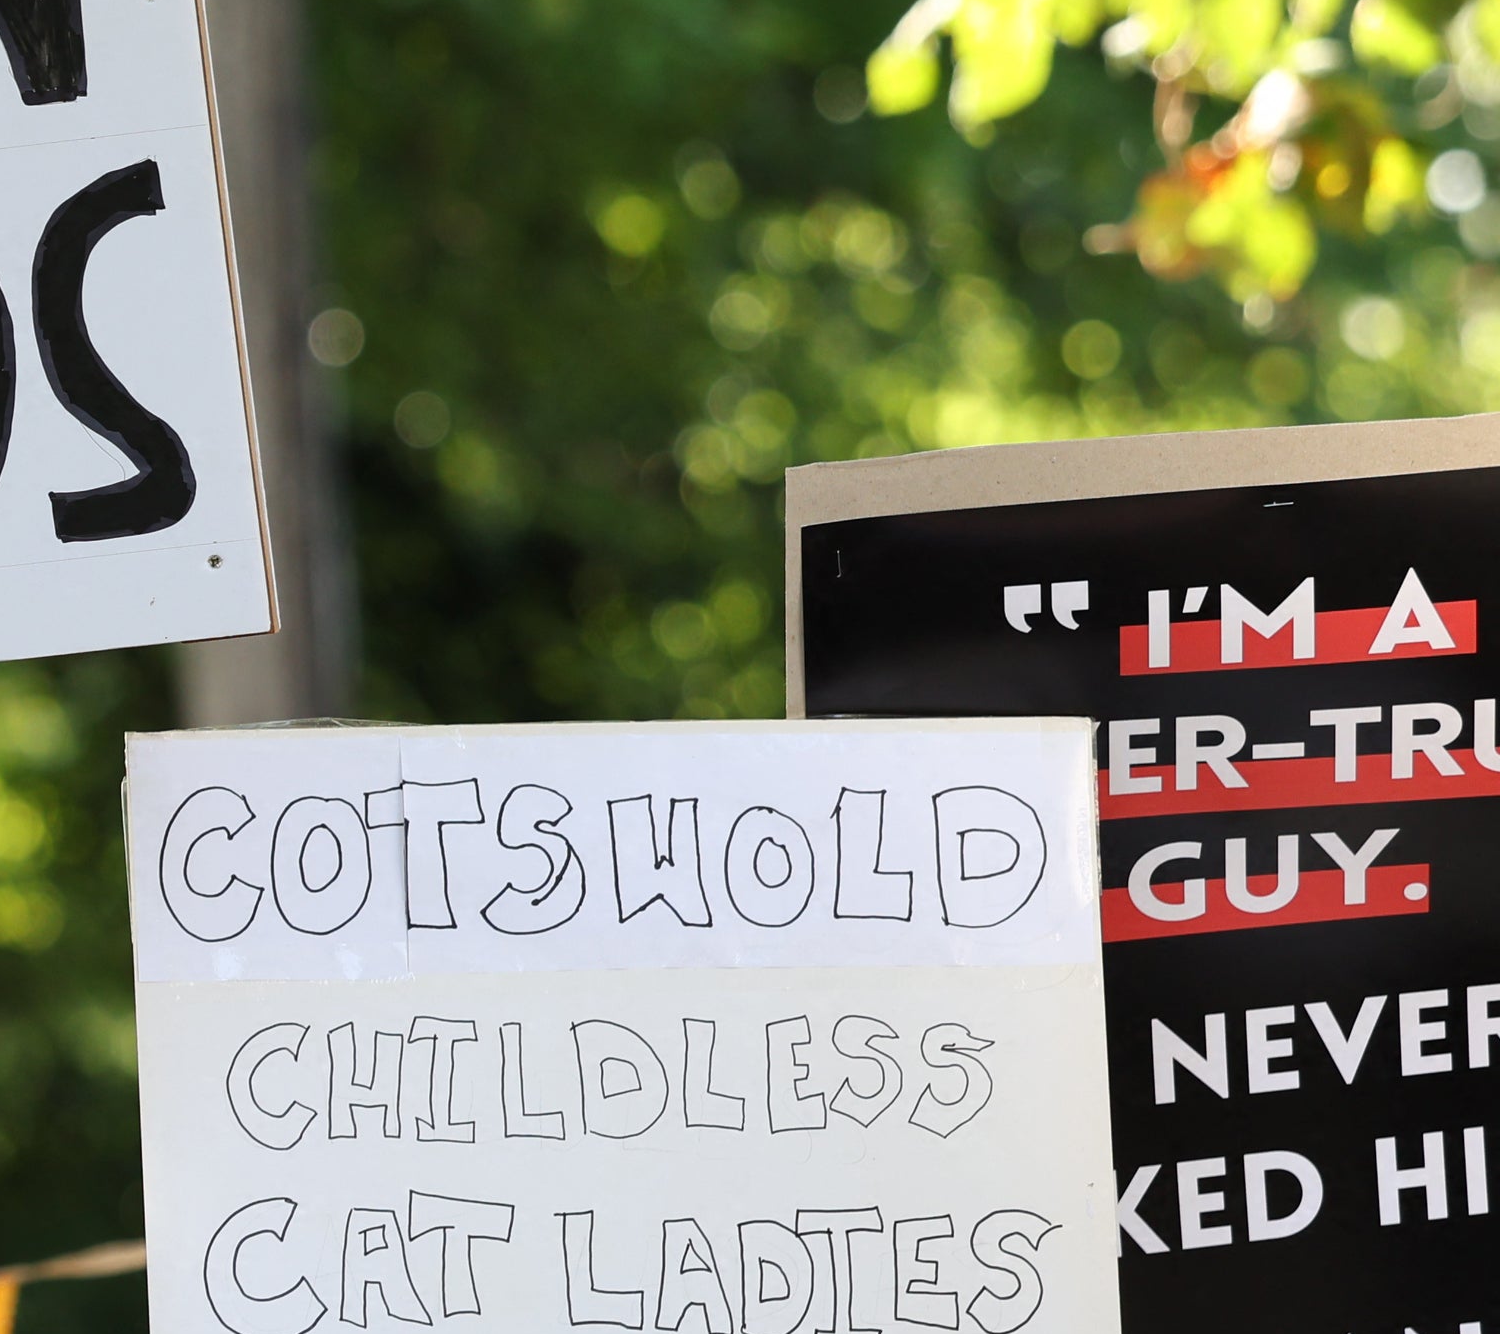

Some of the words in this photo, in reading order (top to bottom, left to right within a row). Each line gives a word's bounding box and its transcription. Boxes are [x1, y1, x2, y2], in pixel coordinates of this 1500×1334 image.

[1367, 566, 1456, 655] A
[159, 777, 1048, 943] COTSWOLD
[1127, 827, 1430, 922] GUY.
[225, 1015, 995, 1151] CHILDLESS
